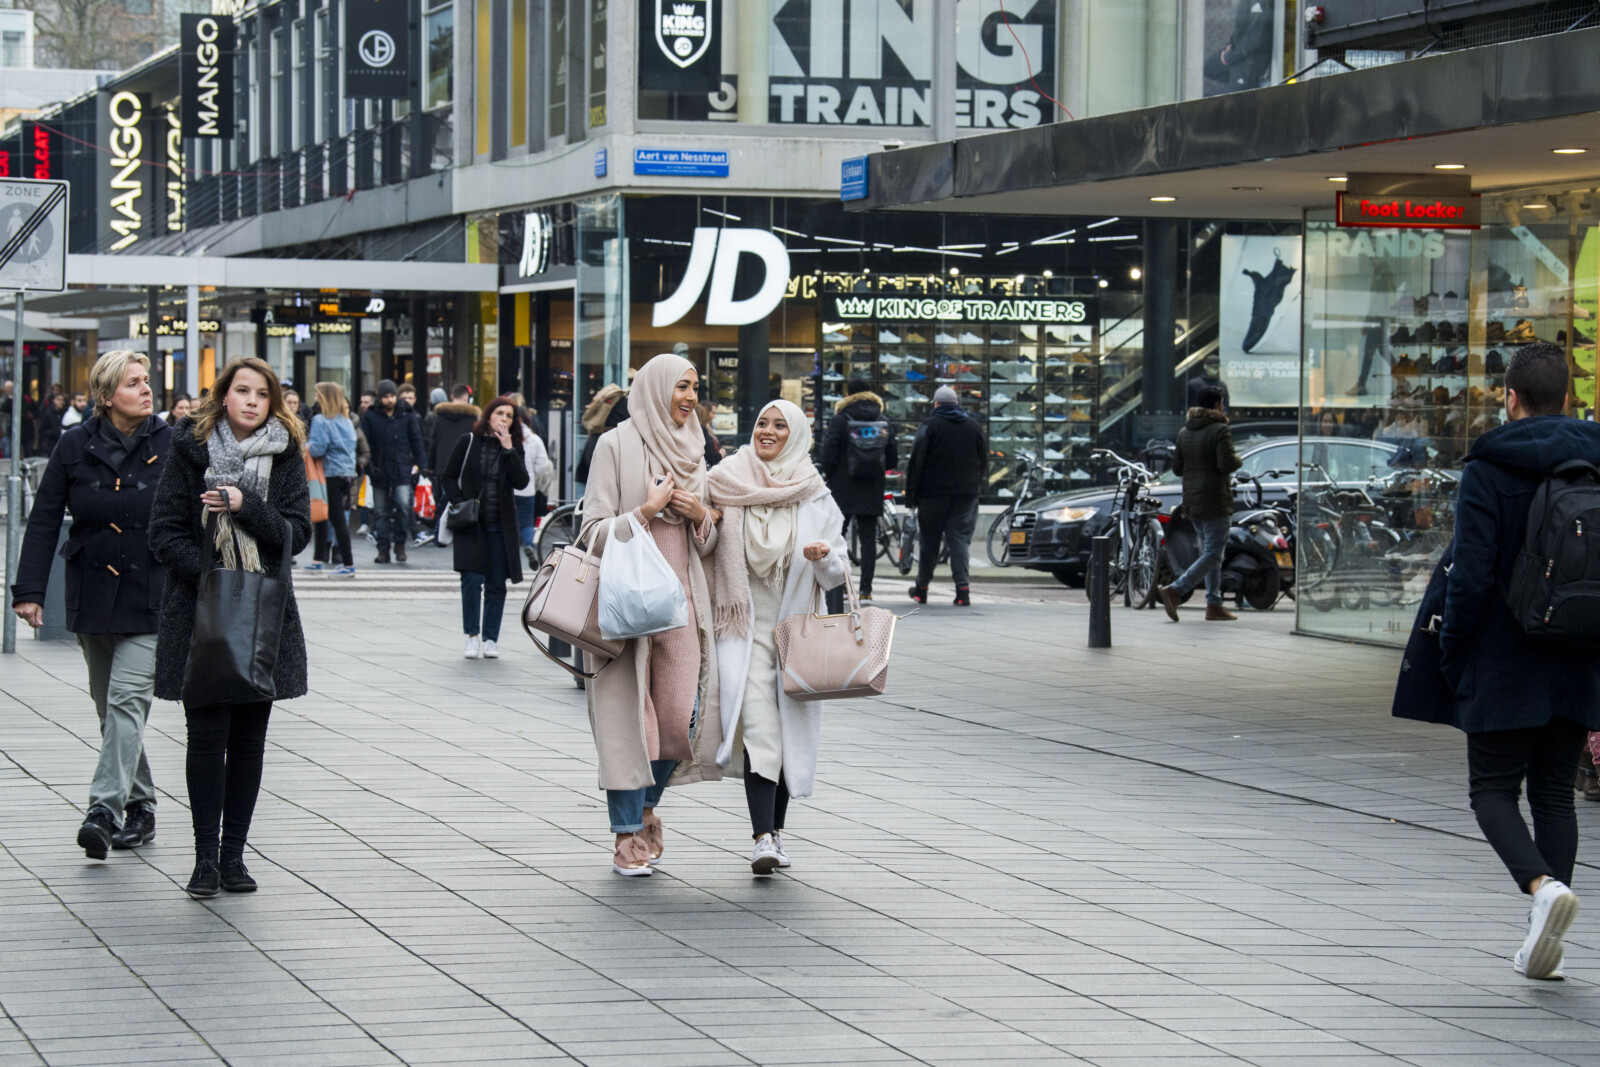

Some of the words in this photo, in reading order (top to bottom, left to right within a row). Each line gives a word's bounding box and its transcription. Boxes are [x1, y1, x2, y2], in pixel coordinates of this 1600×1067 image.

[662, 14, 705, 30] KING
[196, 18, 219, 135] MANGO
[770, 83, 1042, 128] TRAINERS
[638, 151, 660, 160] Aert
[662, 153, 679, 161] van
[681, 152, 726, 163] Nesstraat
[109, 91, 142, 250] MANGO
[5, 185, 41, 197] ZONE
[1360, 200, 1399, 217] Foot
[1405, 201, 1466, 218] Locker
[652, 227, 791, 327] JD
[365, 298, 386, 312] JD
[875, 298, 936, 319] KING
[936, 301, 962, 320] OF
[963, 300, 1087, 322] TRAINERS
